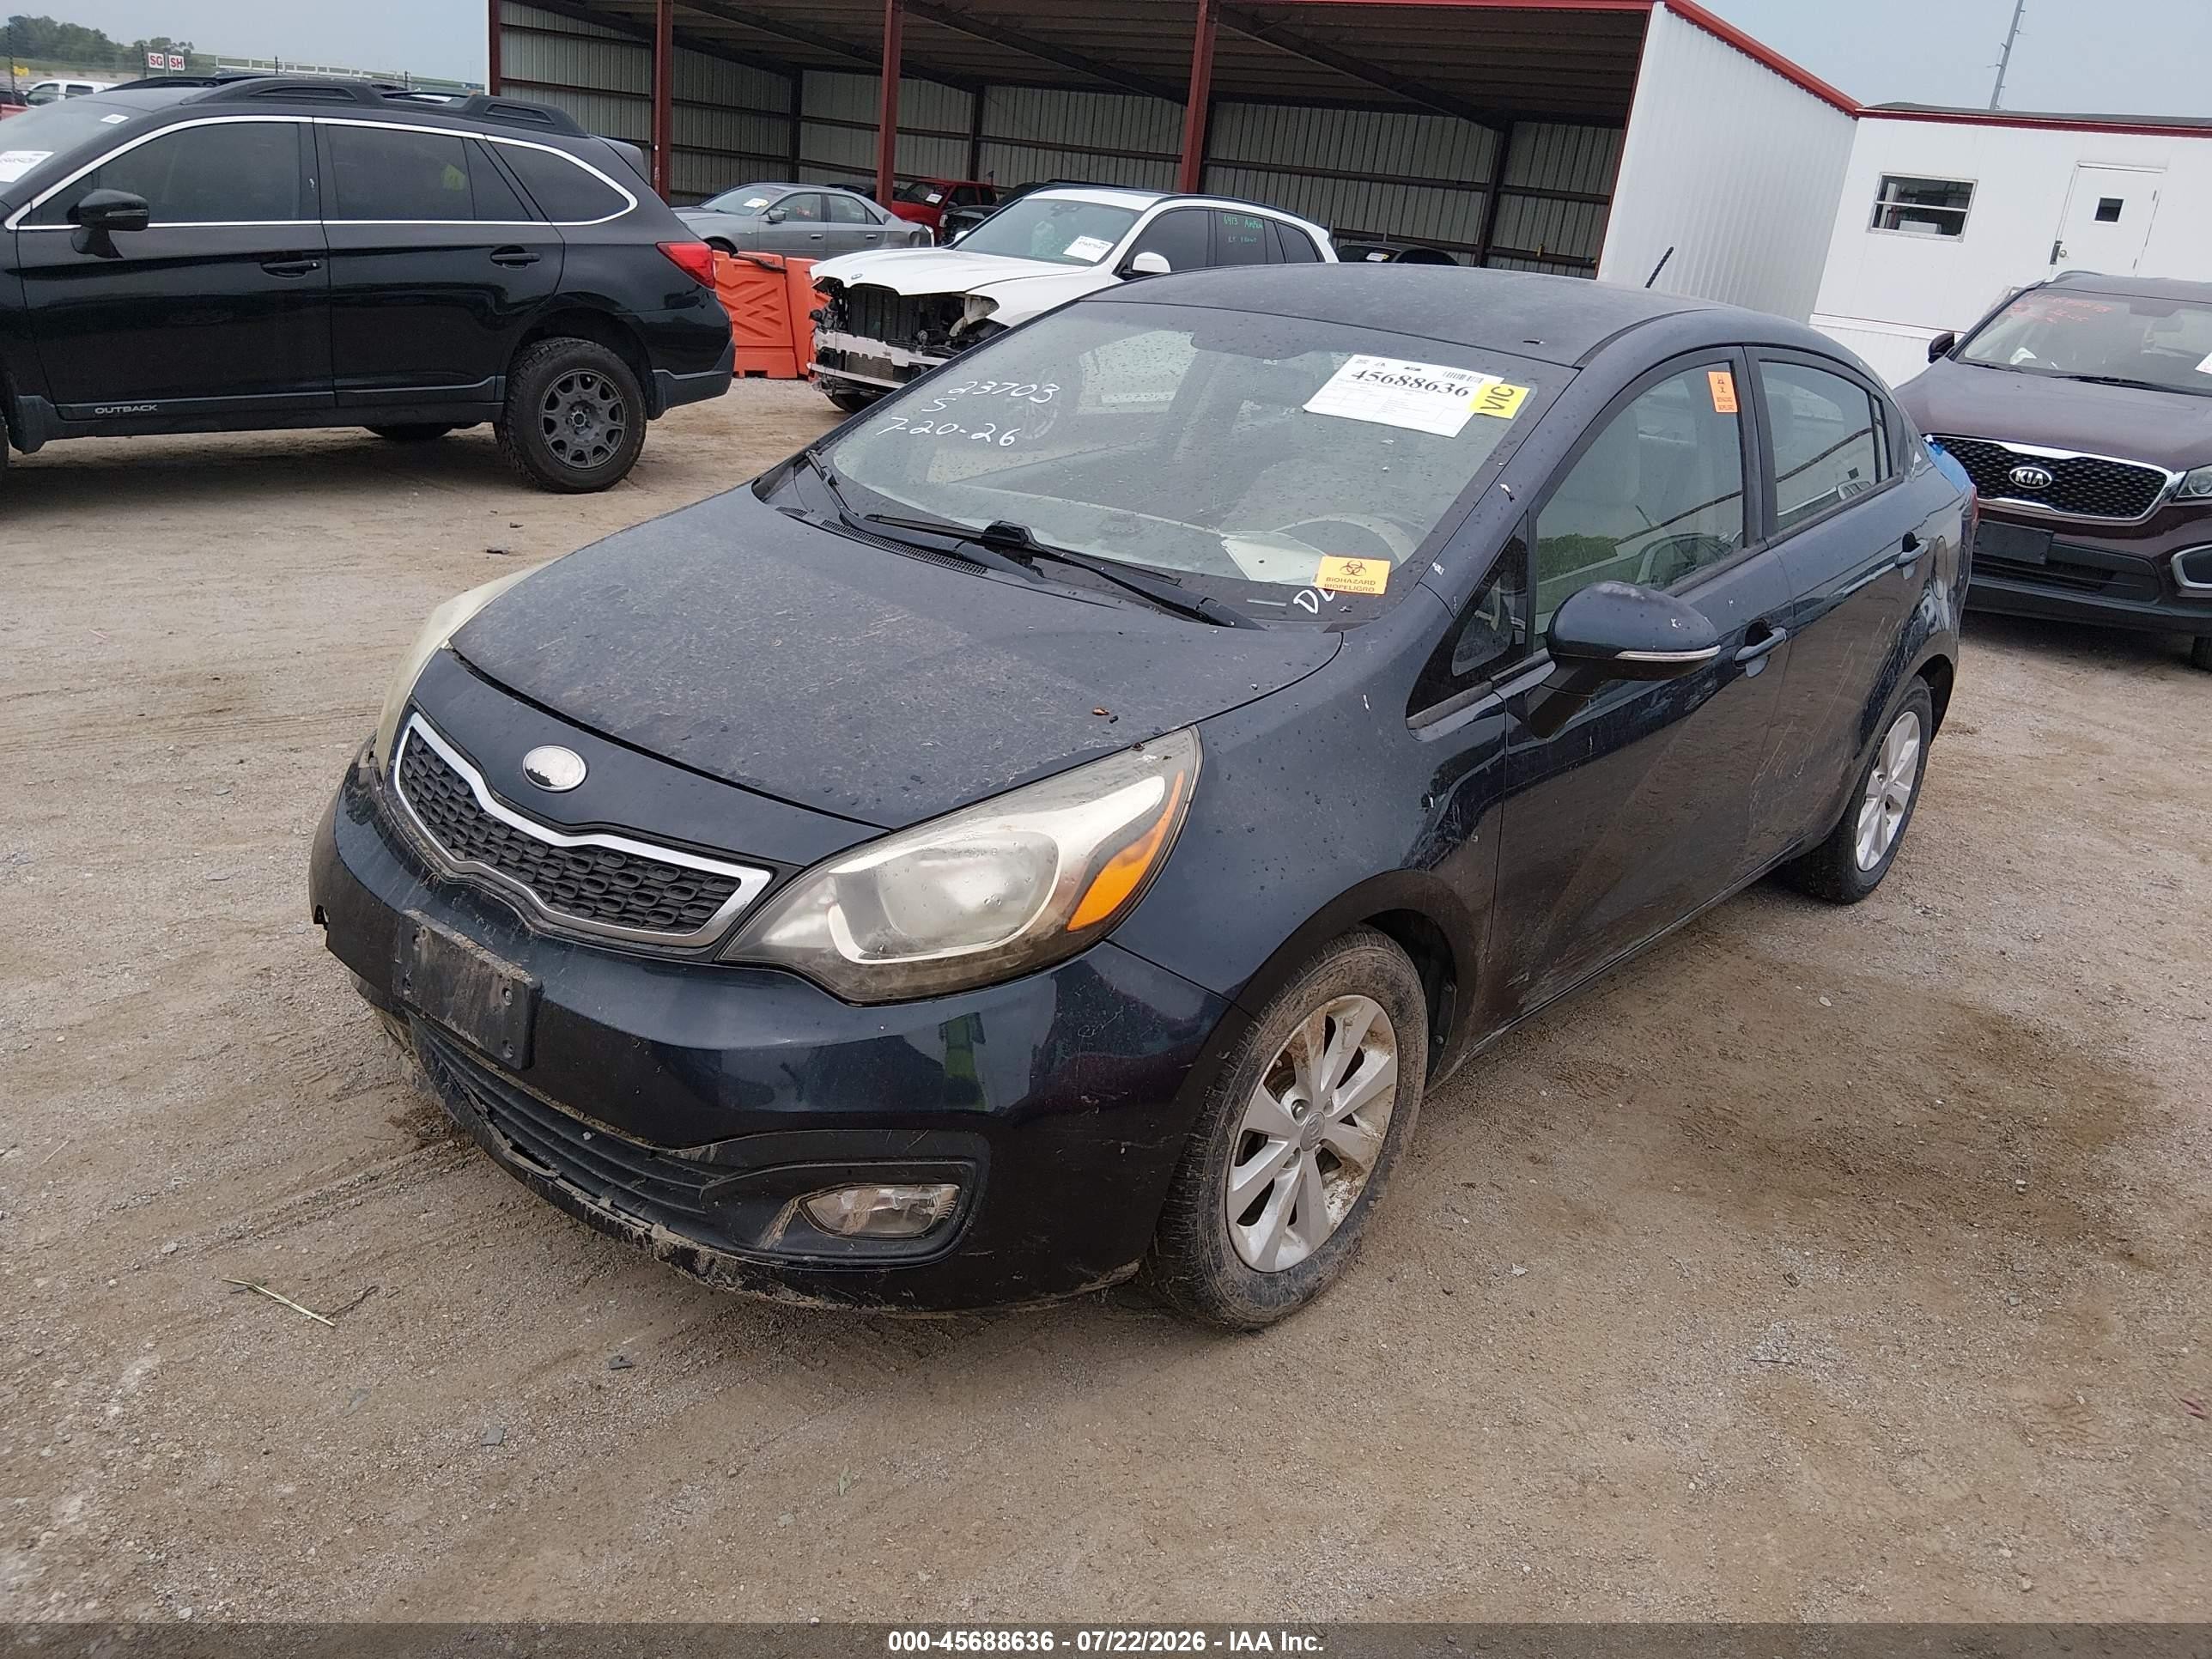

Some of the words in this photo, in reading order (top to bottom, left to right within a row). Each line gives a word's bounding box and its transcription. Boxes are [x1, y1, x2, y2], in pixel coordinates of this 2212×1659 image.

[149, 55, 163, 66] SG
[170, 57, 183, 69] SH
[1350, 369, 1470, 398] 45688636
[947, 380, 1060, 404] 23703
[1479, 386, 1516, 411] VIC
[94, 404, 158, 414] OUTBACK
[875, 416, 1021, 447] 7-20-26
[2014, 470, 2044, 485] KIA
[1323, 583, 1375, 592] BIOPELIGRO
[1325, 576, 1376, 586] BIOHAZARD
